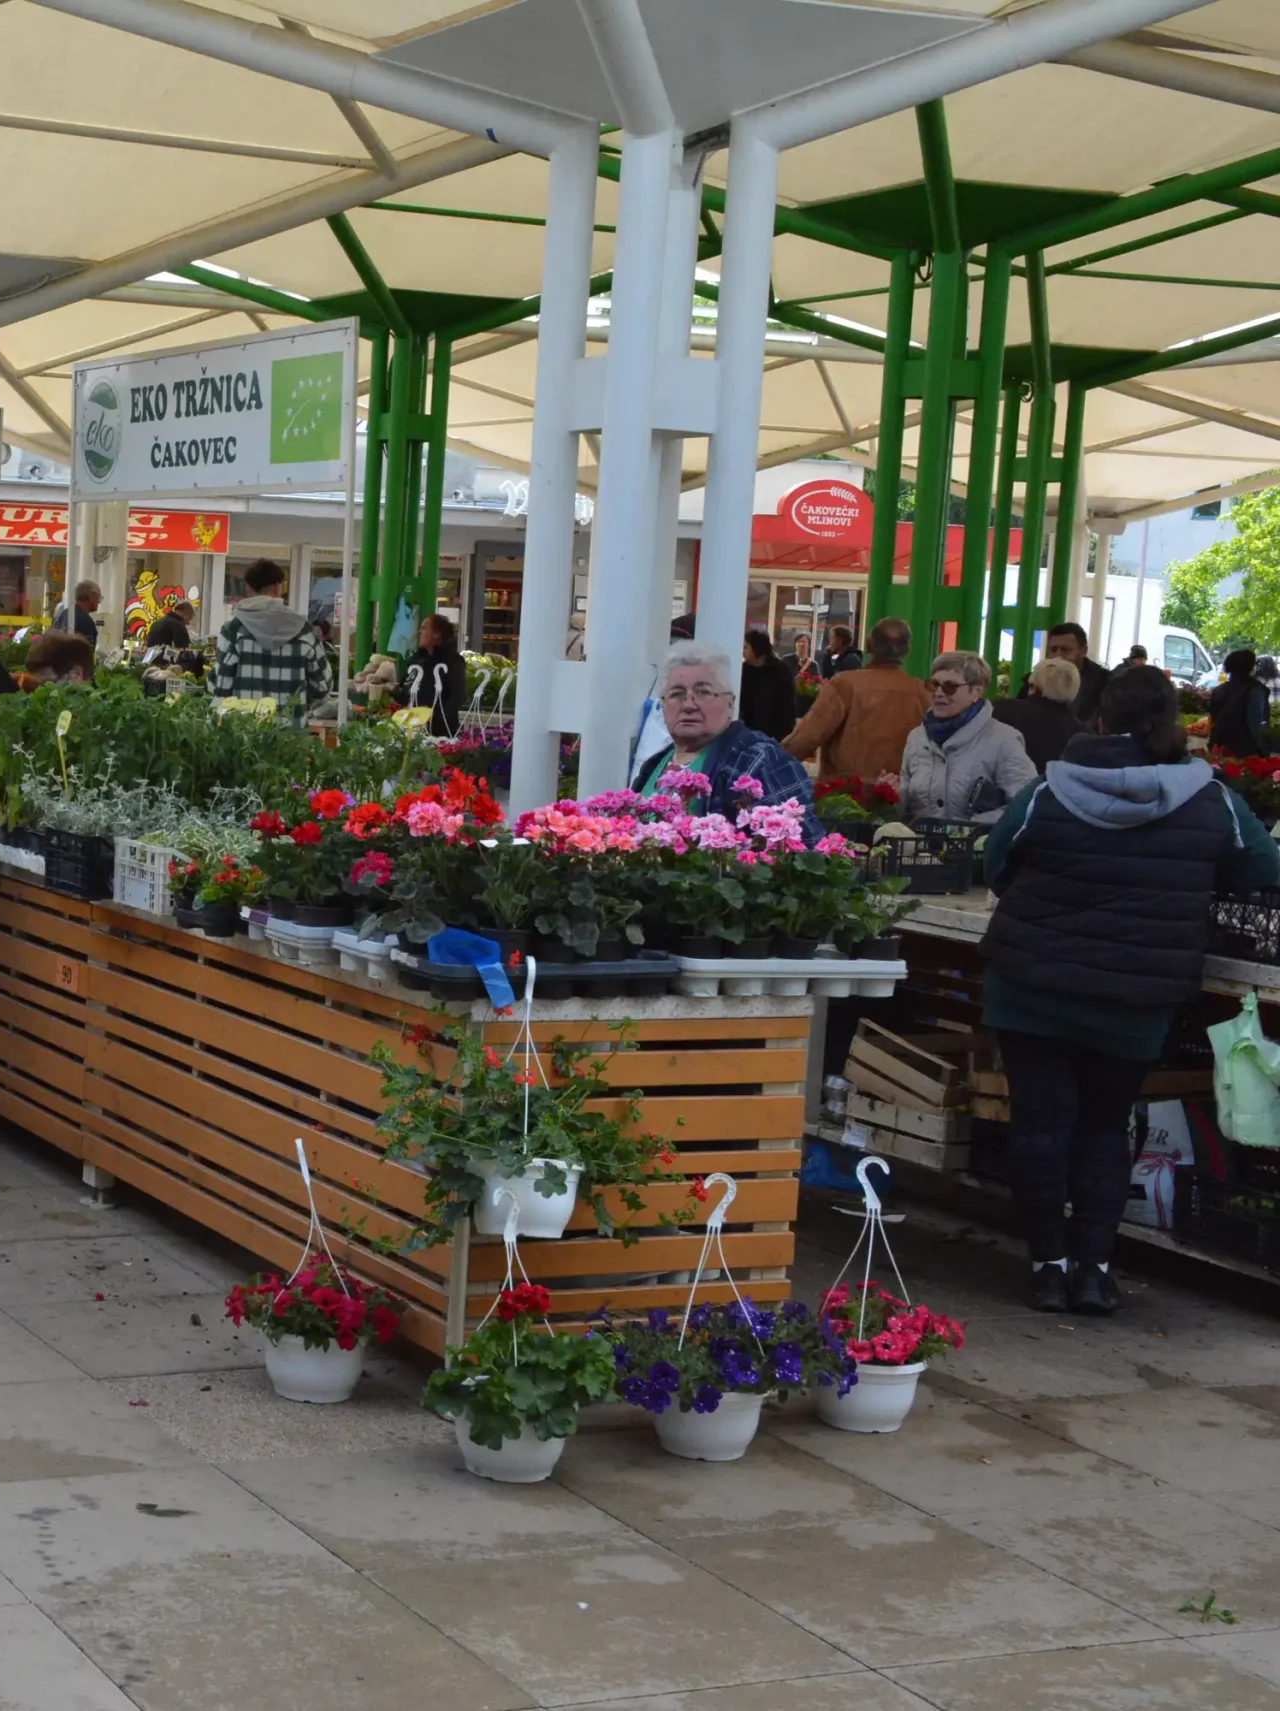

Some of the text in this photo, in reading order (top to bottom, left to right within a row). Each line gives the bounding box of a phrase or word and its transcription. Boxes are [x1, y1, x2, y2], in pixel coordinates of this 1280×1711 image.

[130, 367, 263, 424] EKO TRŽNICA
[86, 410, 115, 452] eko
[150, 436, 237, 469] ČAKOVEC
[800, 502, 860, 518] ČAKOVEČKI
[807, 515, 852, 527] MLINOVI
[61, 965, 72, 984] 90
